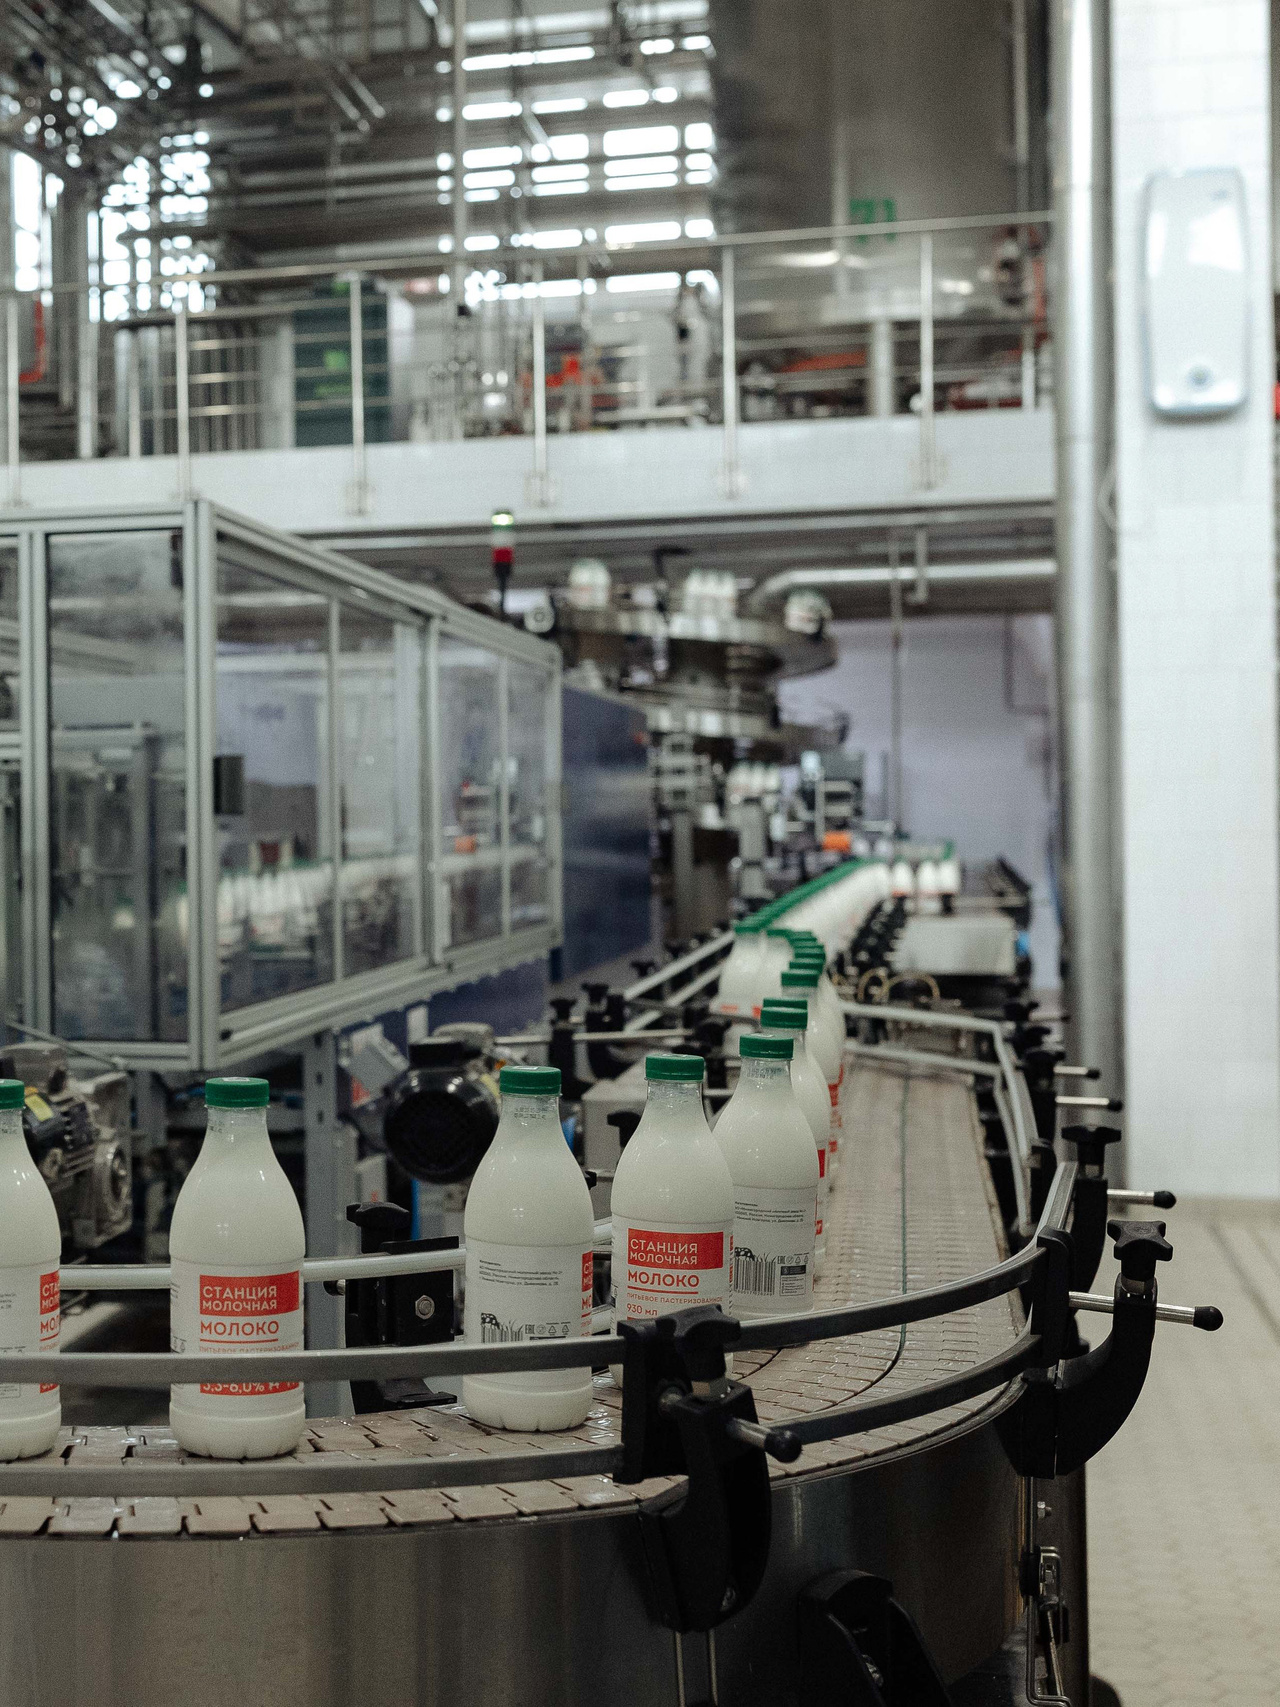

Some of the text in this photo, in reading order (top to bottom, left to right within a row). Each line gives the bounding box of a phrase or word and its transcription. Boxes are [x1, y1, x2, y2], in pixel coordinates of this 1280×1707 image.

[629, 1239, 698, 1255] СТАНЦИЯ
[629, 1251, 698, 1265] МОЛОЧНАЯ
[627, 1269, 700, 1288] МОЛОКО
[202, 1285, 277, 1300] СТАНЦИЯ
[626, 1292, 658, 1302] ПИТЬЕВОЕ
[202, 1299, 277, 1312] МОЛОЧНАЯ
[626, 1303, 643, 1314] 930
[200, 1320, 279, 1336] МОЛОКО
